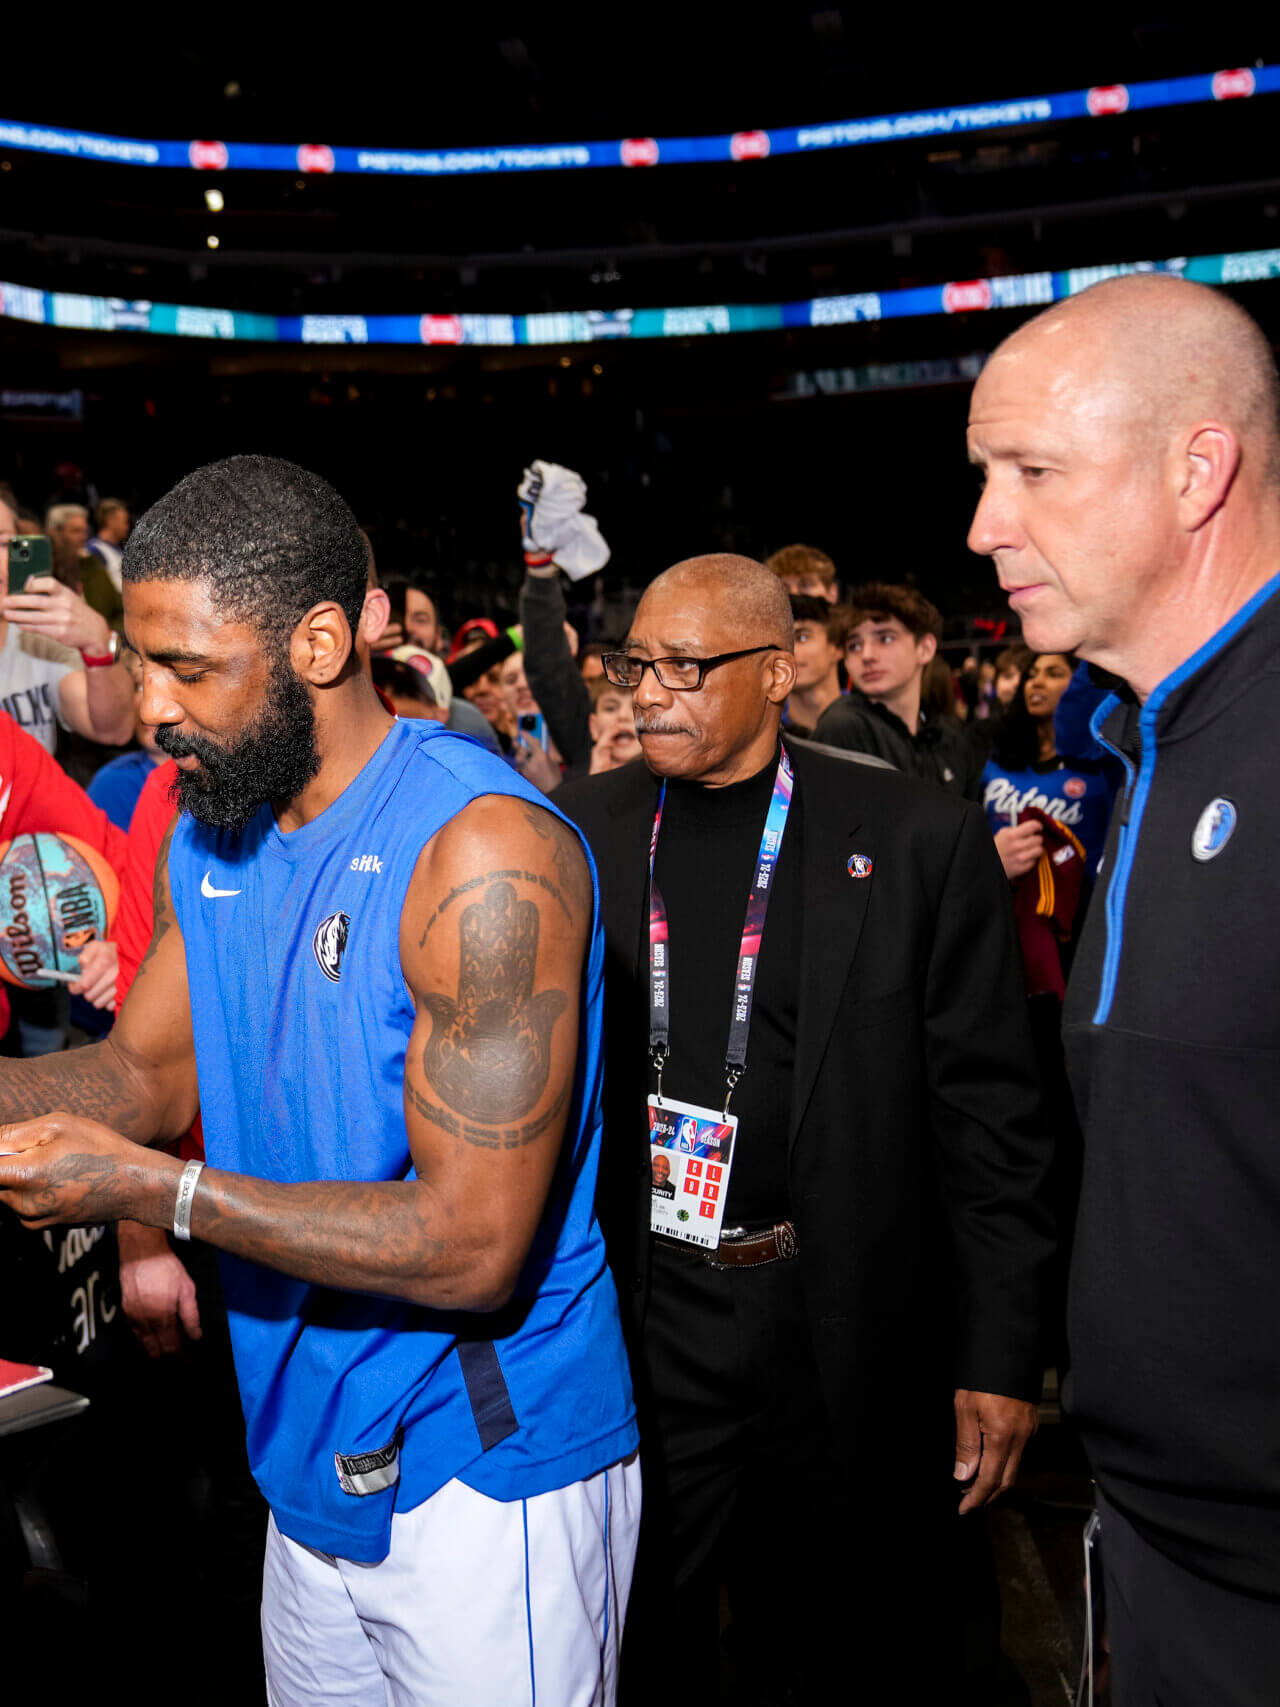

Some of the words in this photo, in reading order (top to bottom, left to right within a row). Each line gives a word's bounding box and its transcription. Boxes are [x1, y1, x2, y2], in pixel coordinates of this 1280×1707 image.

[983, 777, 1084, 828] Pistons
[756, 863, 772, 889] 2023-24
[56, 882, 95, 930] NBA
[6, 872, 44, 976] Wilson
[653, 943, 665, 967] SEASON
[740, 957, 753, 981] SEASON
[653, 980, 665, 1008] 2023-24
[735, 994, 749, 1022] 2023-24
[652, 1121, 676, 1136] 2023-24
[700, 1133, 721, 1148] SEASON
